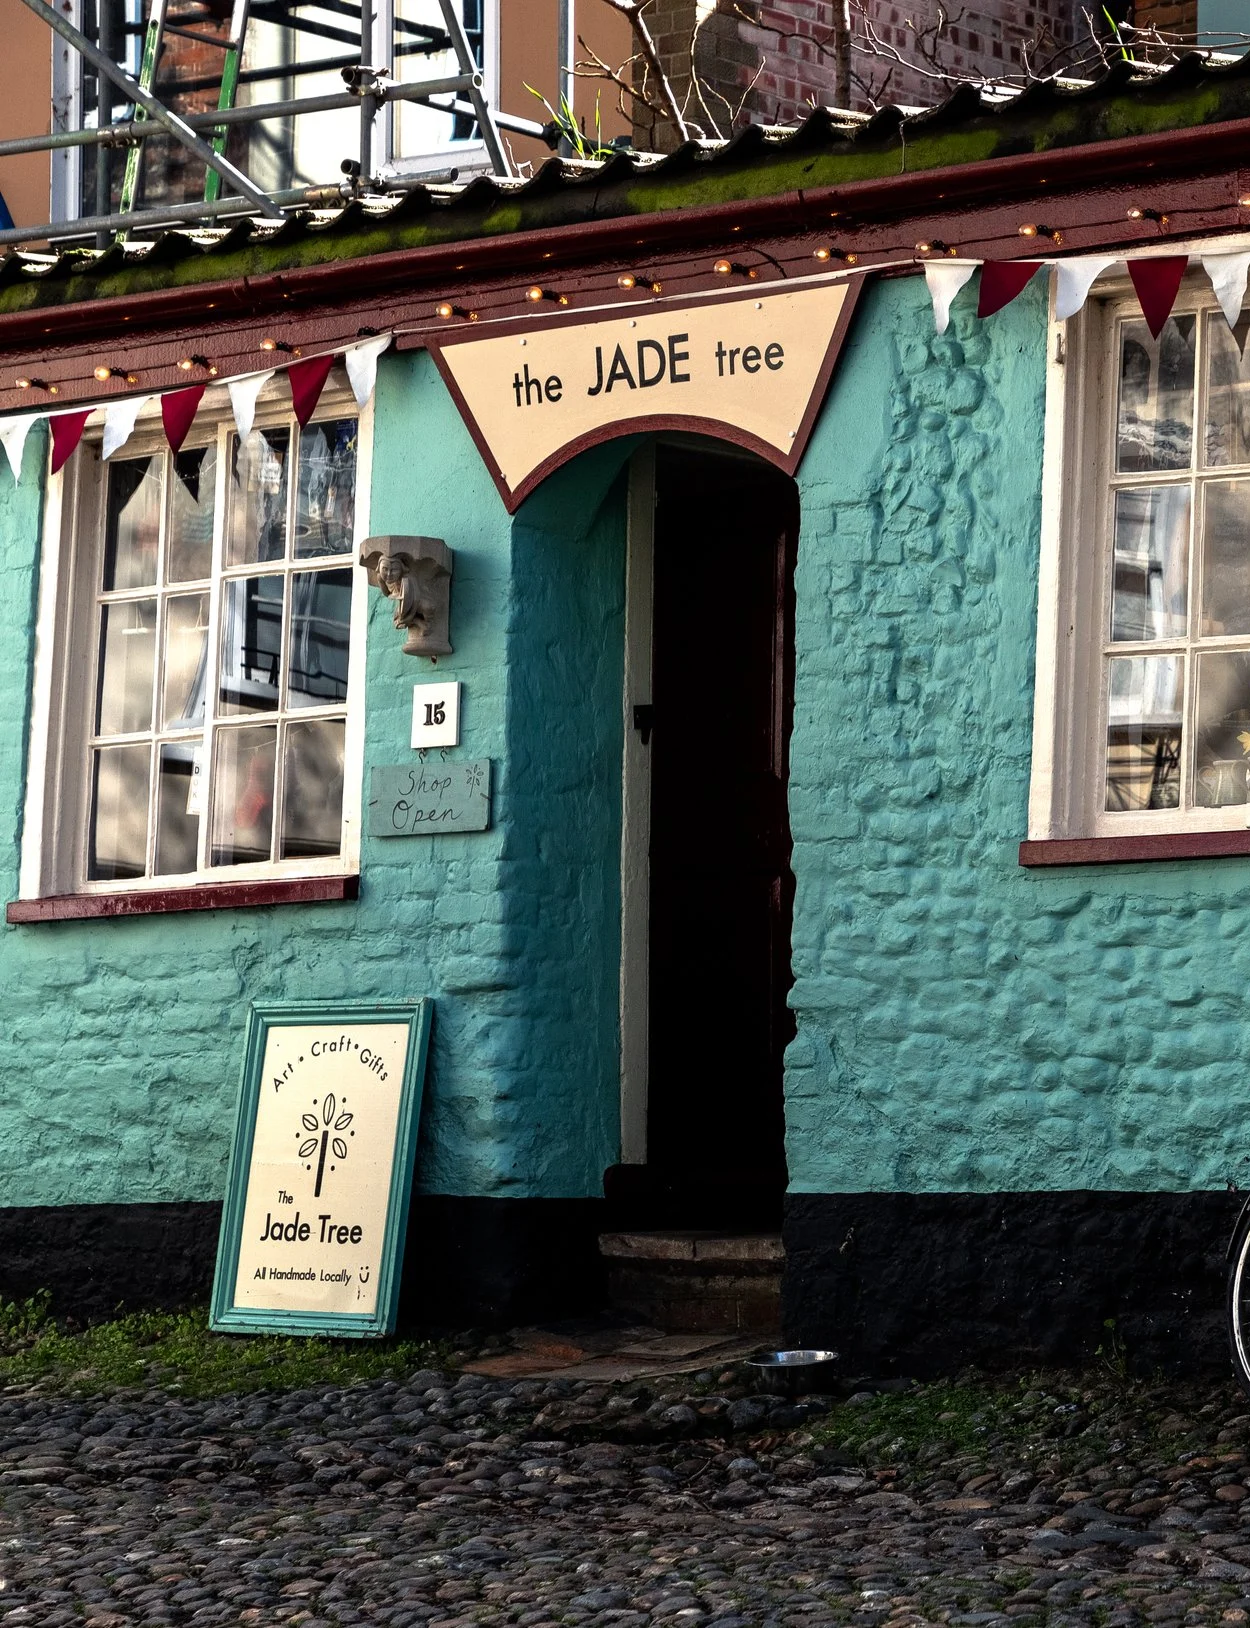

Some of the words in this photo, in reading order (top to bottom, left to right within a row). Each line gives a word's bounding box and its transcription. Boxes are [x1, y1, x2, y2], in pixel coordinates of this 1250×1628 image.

[512, 363, 563, 407] the
[587, 332, 691, 397] JADE
[715, 341, 785, 377] tree
[423, 700, 446, 726] 15
[398, 767, 452, 799] Shop
[391, 799, 462, 832] Open
[273, 1062, 294, 1093] Art
[311, 1035, 352, 1057] Craft
[360, 1048, 388, 1082] Gifts
[278, 1190, 294, 1205] The
[259, 1211, 311, 1242] Jade
[318, 1214, 363, 1244] Tree
[253, 1266, 267, 1280] All
[269, 1267, 317, 1281] Handmade
[319, 1268, 352, 1287] Locally
